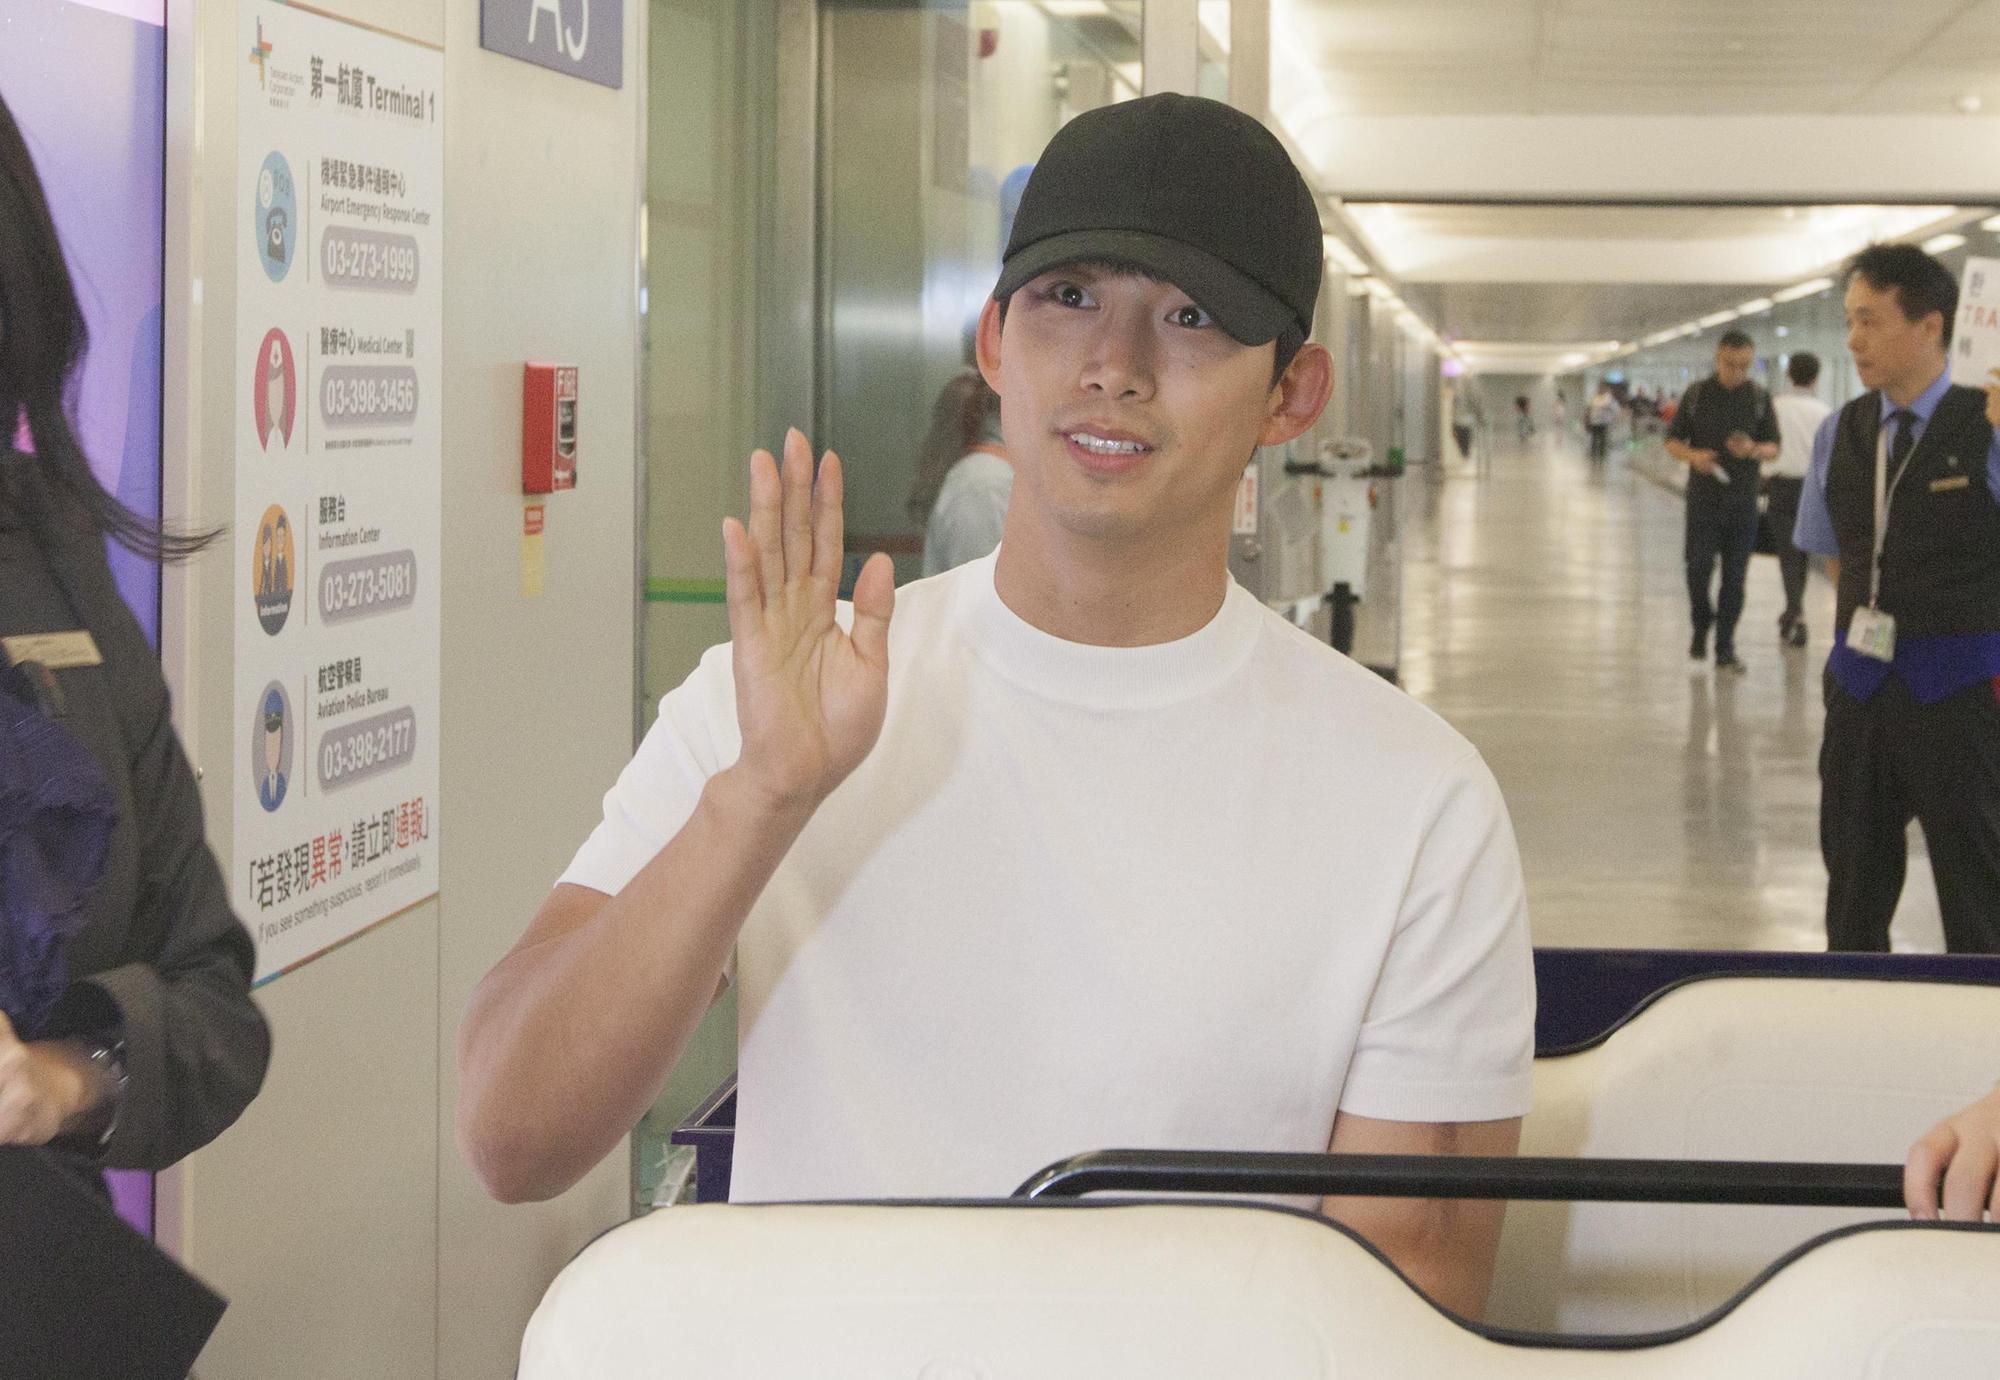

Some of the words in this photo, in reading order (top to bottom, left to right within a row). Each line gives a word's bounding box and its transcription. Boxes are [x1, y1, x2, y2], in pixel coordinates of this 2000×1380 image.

[310, 56, 363, 108] 第一航廈
[367, 77, 423, 119] Terminal
[428, 92, 435, 122] 1
[321, 195, 345, 214] Airport
[346, 199, 382, 221] Emergency
[383, 203, 410, 222] Response
[411, 208, 430, 225] Center
[327, 239, 414, 282] 03-273-1999
[321, 327, 356, 355] 醫療中心
[357, 336, 382, 353] Medical
[383, 337, 403, 353] Center
[327, 379, 413, 415] 03-398-3456
[319, 495, 346, 524] 服務台
[318, 530, 357, 550] Information
[359, 526, 380, 544] Center
[325, 563, 410, 612] 03-273-5081
[318, 657, 362, 693] 航空警察局
[317, 695, 345, 719] Aviation
[345, 690, 364, 710] Police
[366, 686, 388, 706] Bureau
[324, 719, 411, 780] 03-398-2177
[279, 914, 293, 931] see
